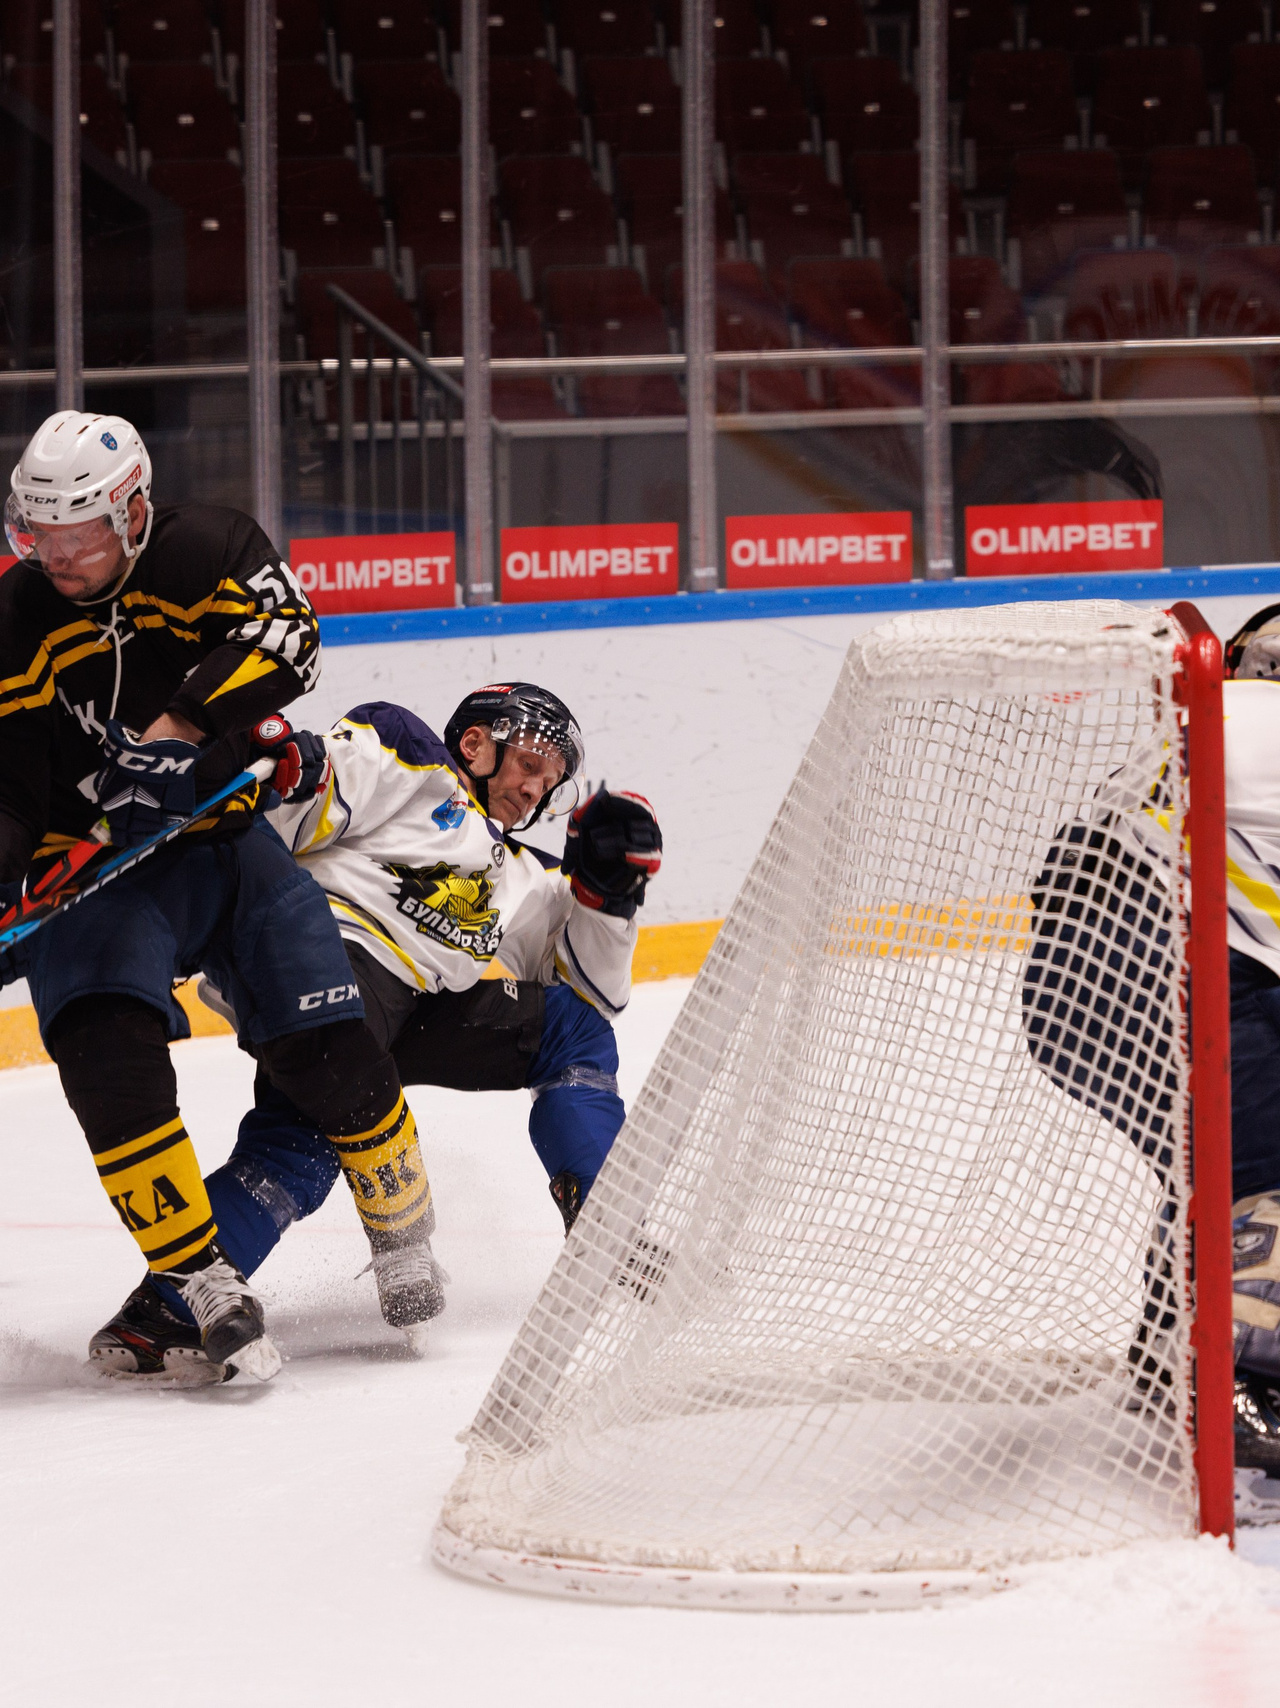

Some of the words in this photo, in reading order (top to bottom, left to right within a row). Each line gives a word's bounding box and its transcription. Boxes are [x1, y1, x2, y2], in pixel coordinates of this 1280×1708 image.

[24, 494, 58, 504] CCM
[113, 466, 141, 503] FONBET
[731, 534, 907, 567] OLIMPBET
[971, 522, 1157, 555] OLIMPBET
[294, 555, 451, 592] OLIMPBET
[506, 546, 673, 579] OLIMPBET
[298, 983, 360, 1011] CCM
